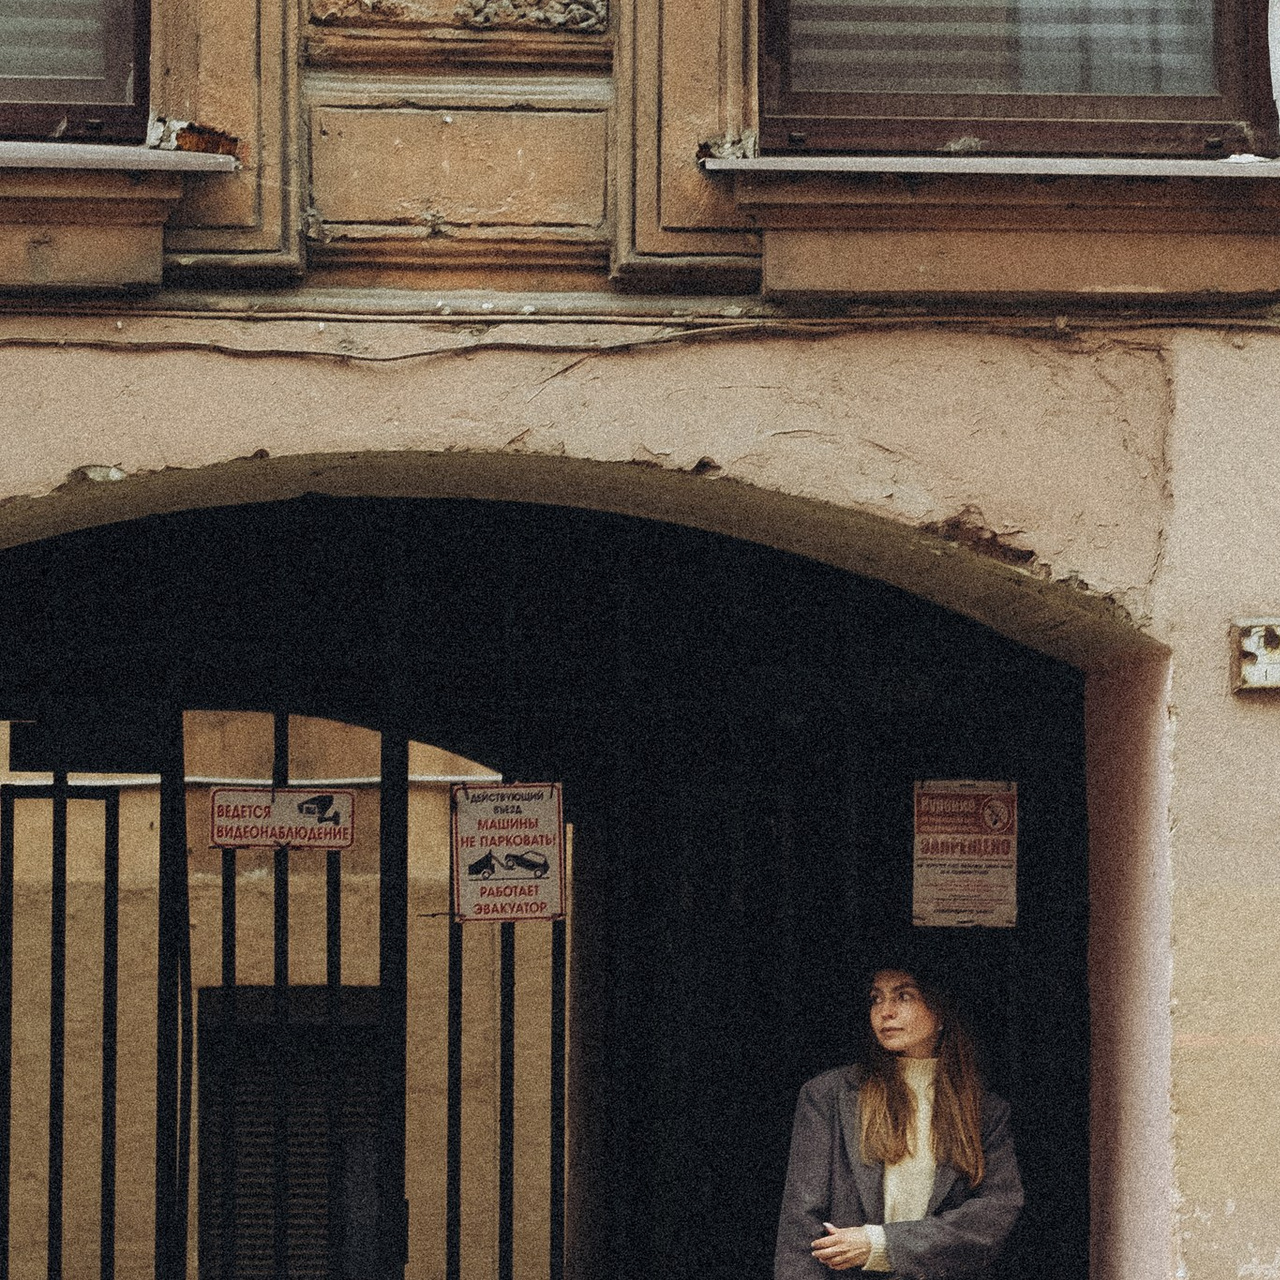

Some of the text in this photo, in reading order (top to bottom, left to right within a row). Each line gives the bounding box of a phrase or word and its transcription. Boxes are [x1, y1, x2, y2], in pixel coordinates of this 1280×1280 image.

[470, 790, 545, 804] ДЕЙСТВУЮЩИЙ
[216, 805, 272, 819] ВЕДЕТСЯ
[493, 805, 522, 815] ВЪЕЗД
[477, 818, 539, 831] МАШИНЫ
[216, 825, 349, 841] ВИДЕОНАБЛЮДЕНИЕ
[460, 833, 556, 848] НЕ ПАРКОВАТЬ!
[920, 838, 1011, 856] ЗАПРЕЩЕНО
[480, 885, 540, 898] РАБОТАЕТ
[473, 901, 547, 916] ЭВАКУАТОР
